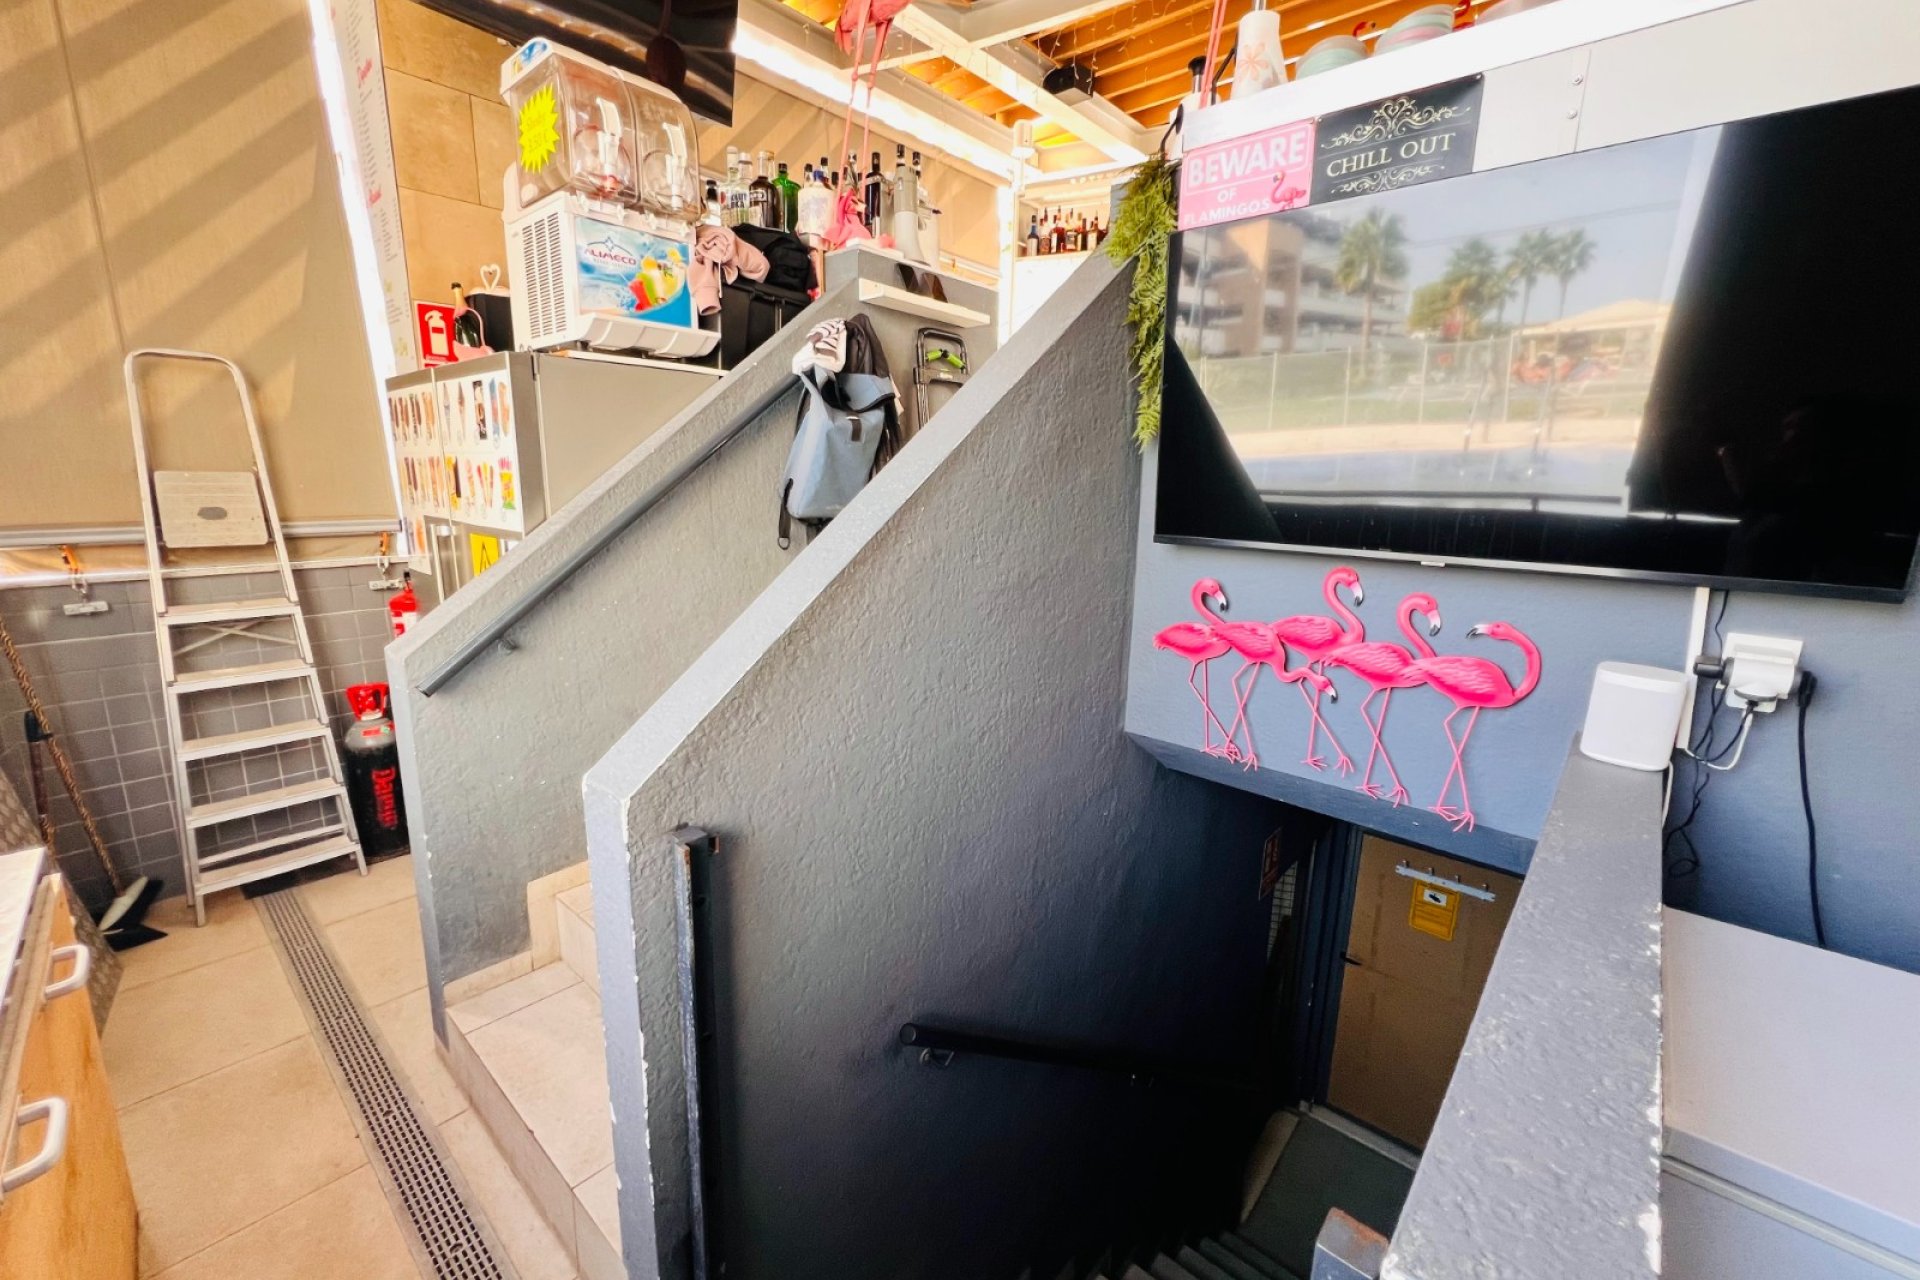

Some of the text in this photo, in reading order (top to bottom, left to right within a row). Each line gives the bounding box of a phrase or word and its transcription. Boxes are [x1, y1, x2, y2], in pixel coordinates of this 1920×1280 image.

[1190, 131, 1306, 187] BEWARE
[1326, 132, 1456, 177] CHILL OUT
[1185, 199, 1270, 224] FLAMINGOS
[1217, 188, 1237, 203] OF
